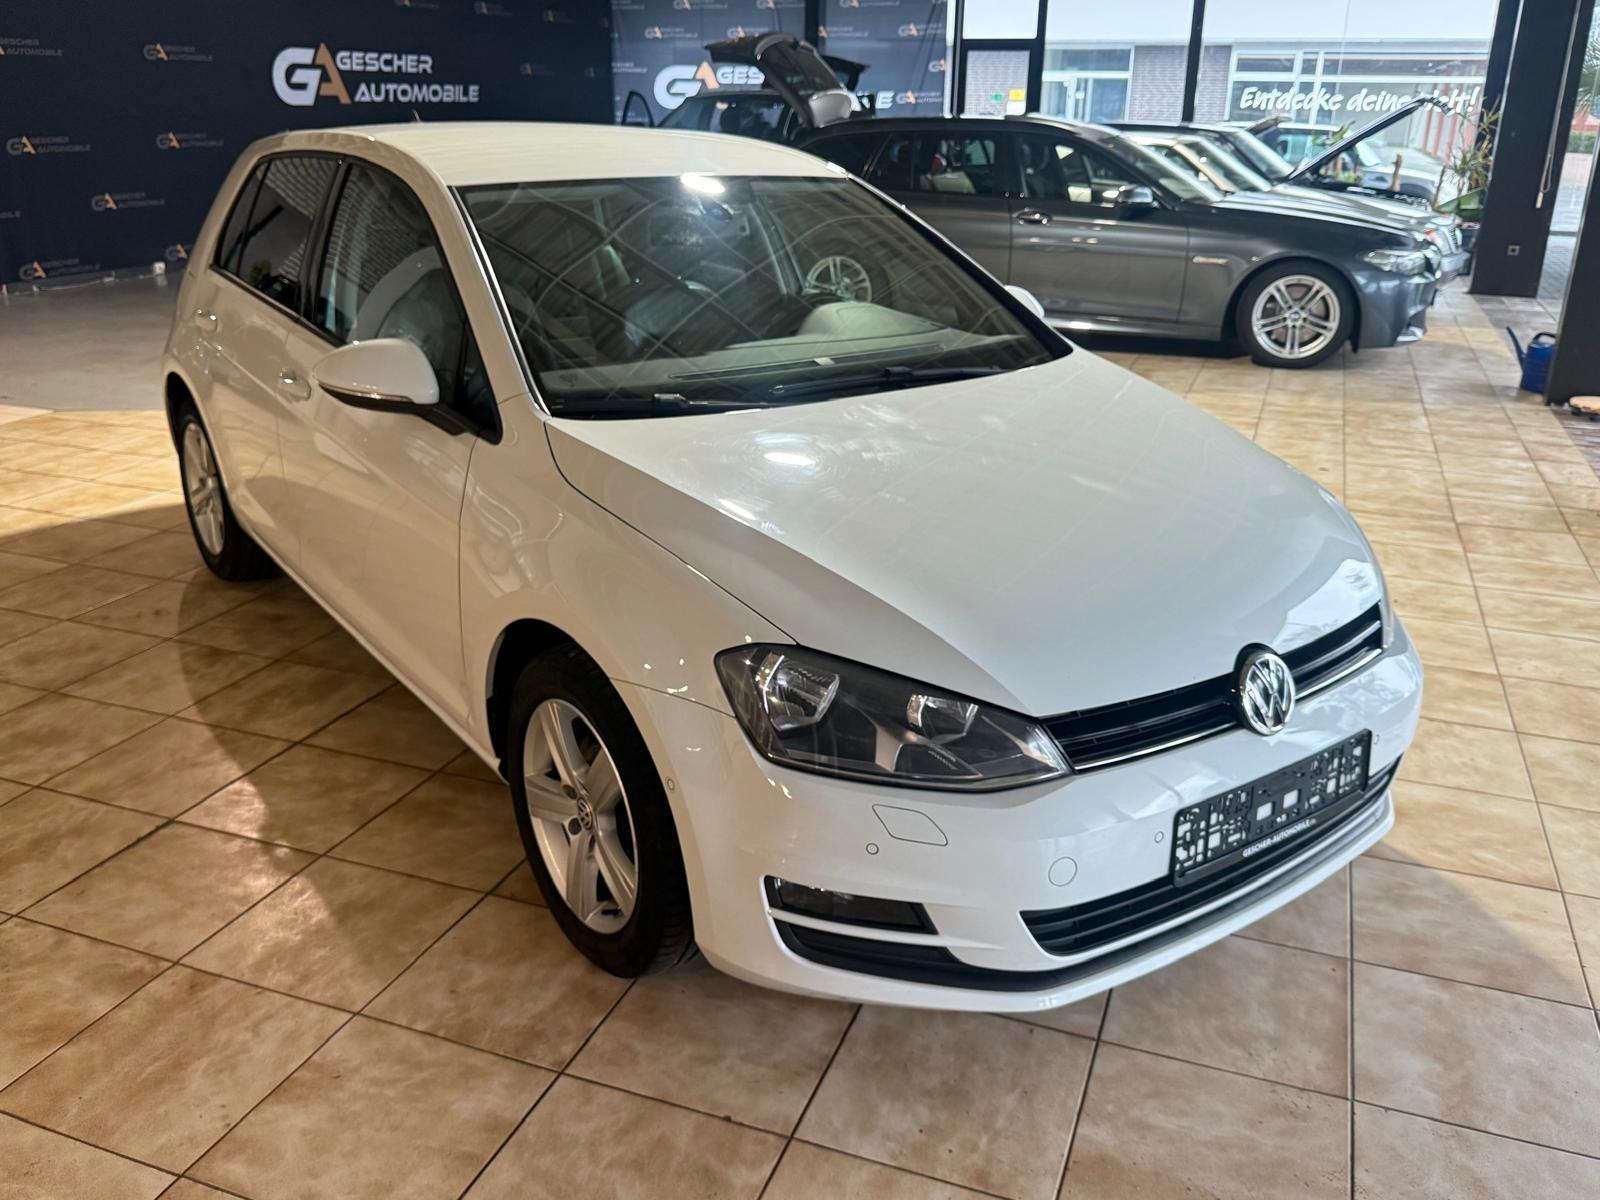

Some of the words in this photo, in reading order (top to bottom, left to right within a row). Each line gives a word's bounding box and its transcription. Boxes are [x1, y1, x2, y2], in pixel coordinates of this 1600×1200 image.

[335, 50, 433, 74] GESCHER
[272, 43, 352, 106] GA
[716, 65, 766, 85] GES
[354, 82, 480, 103] AUTOMOBILE
